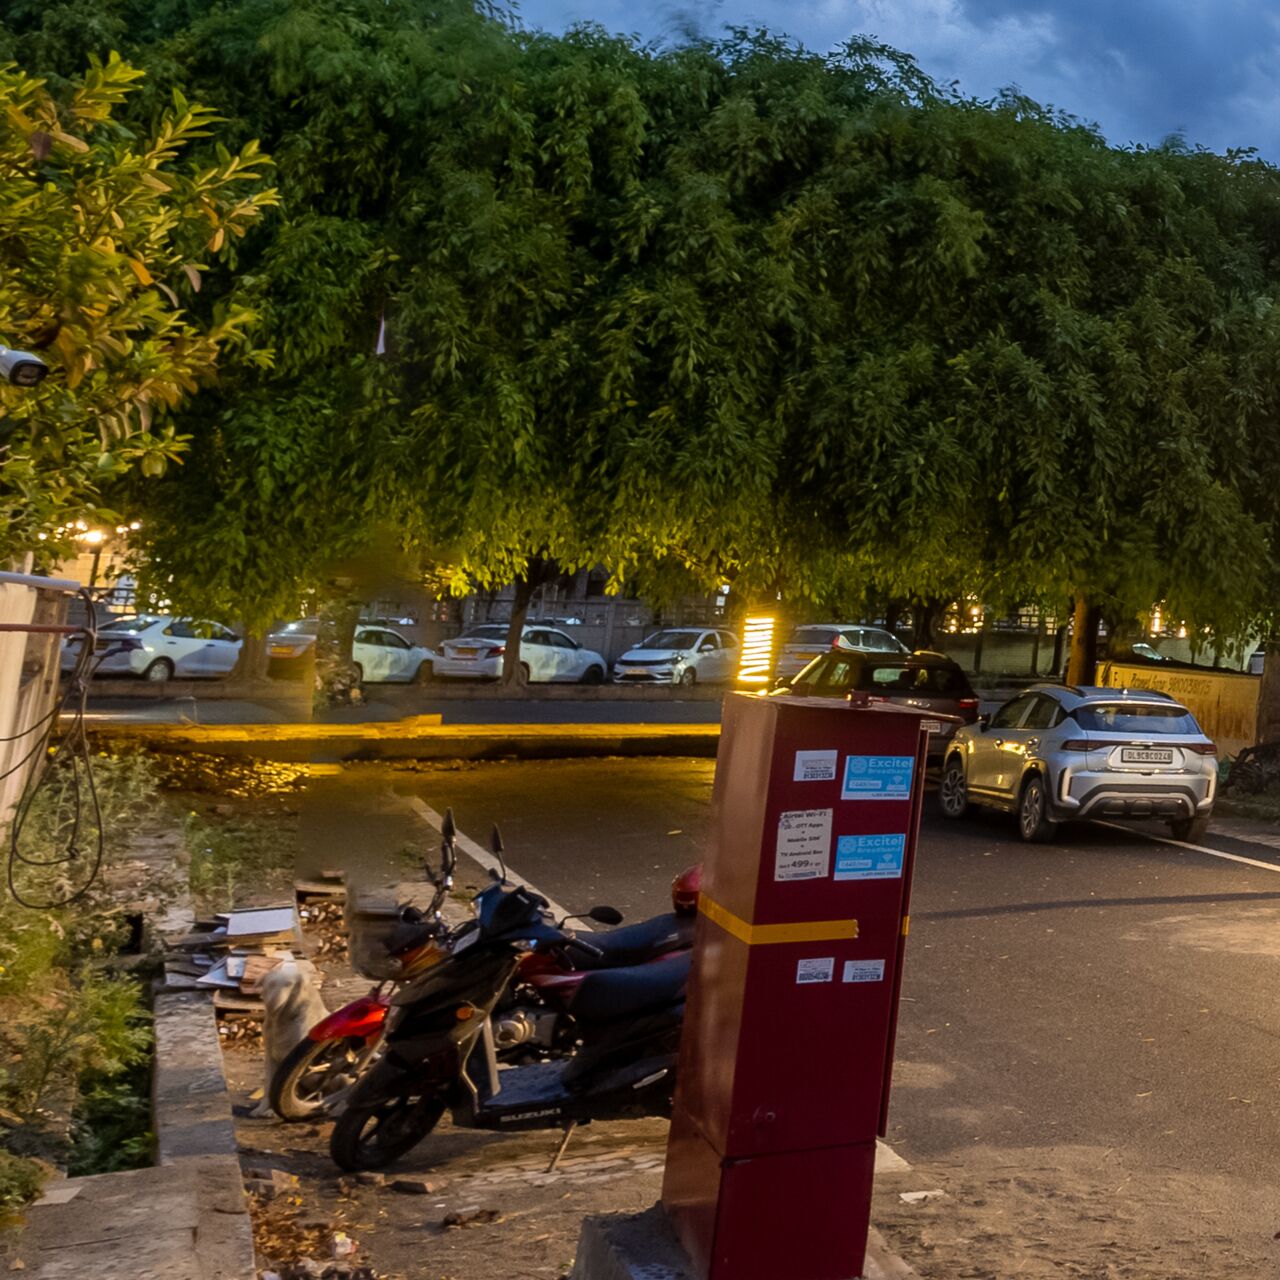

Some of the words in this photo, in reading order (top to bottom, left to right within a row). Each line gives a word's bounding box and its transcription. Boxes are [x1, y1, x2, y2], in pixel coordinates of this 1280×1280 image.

[869, 757, 913, 768] Excitel
[858, 836, 903, 847] Excitel
[500, 1108, 561, 1122] SUZUKI
